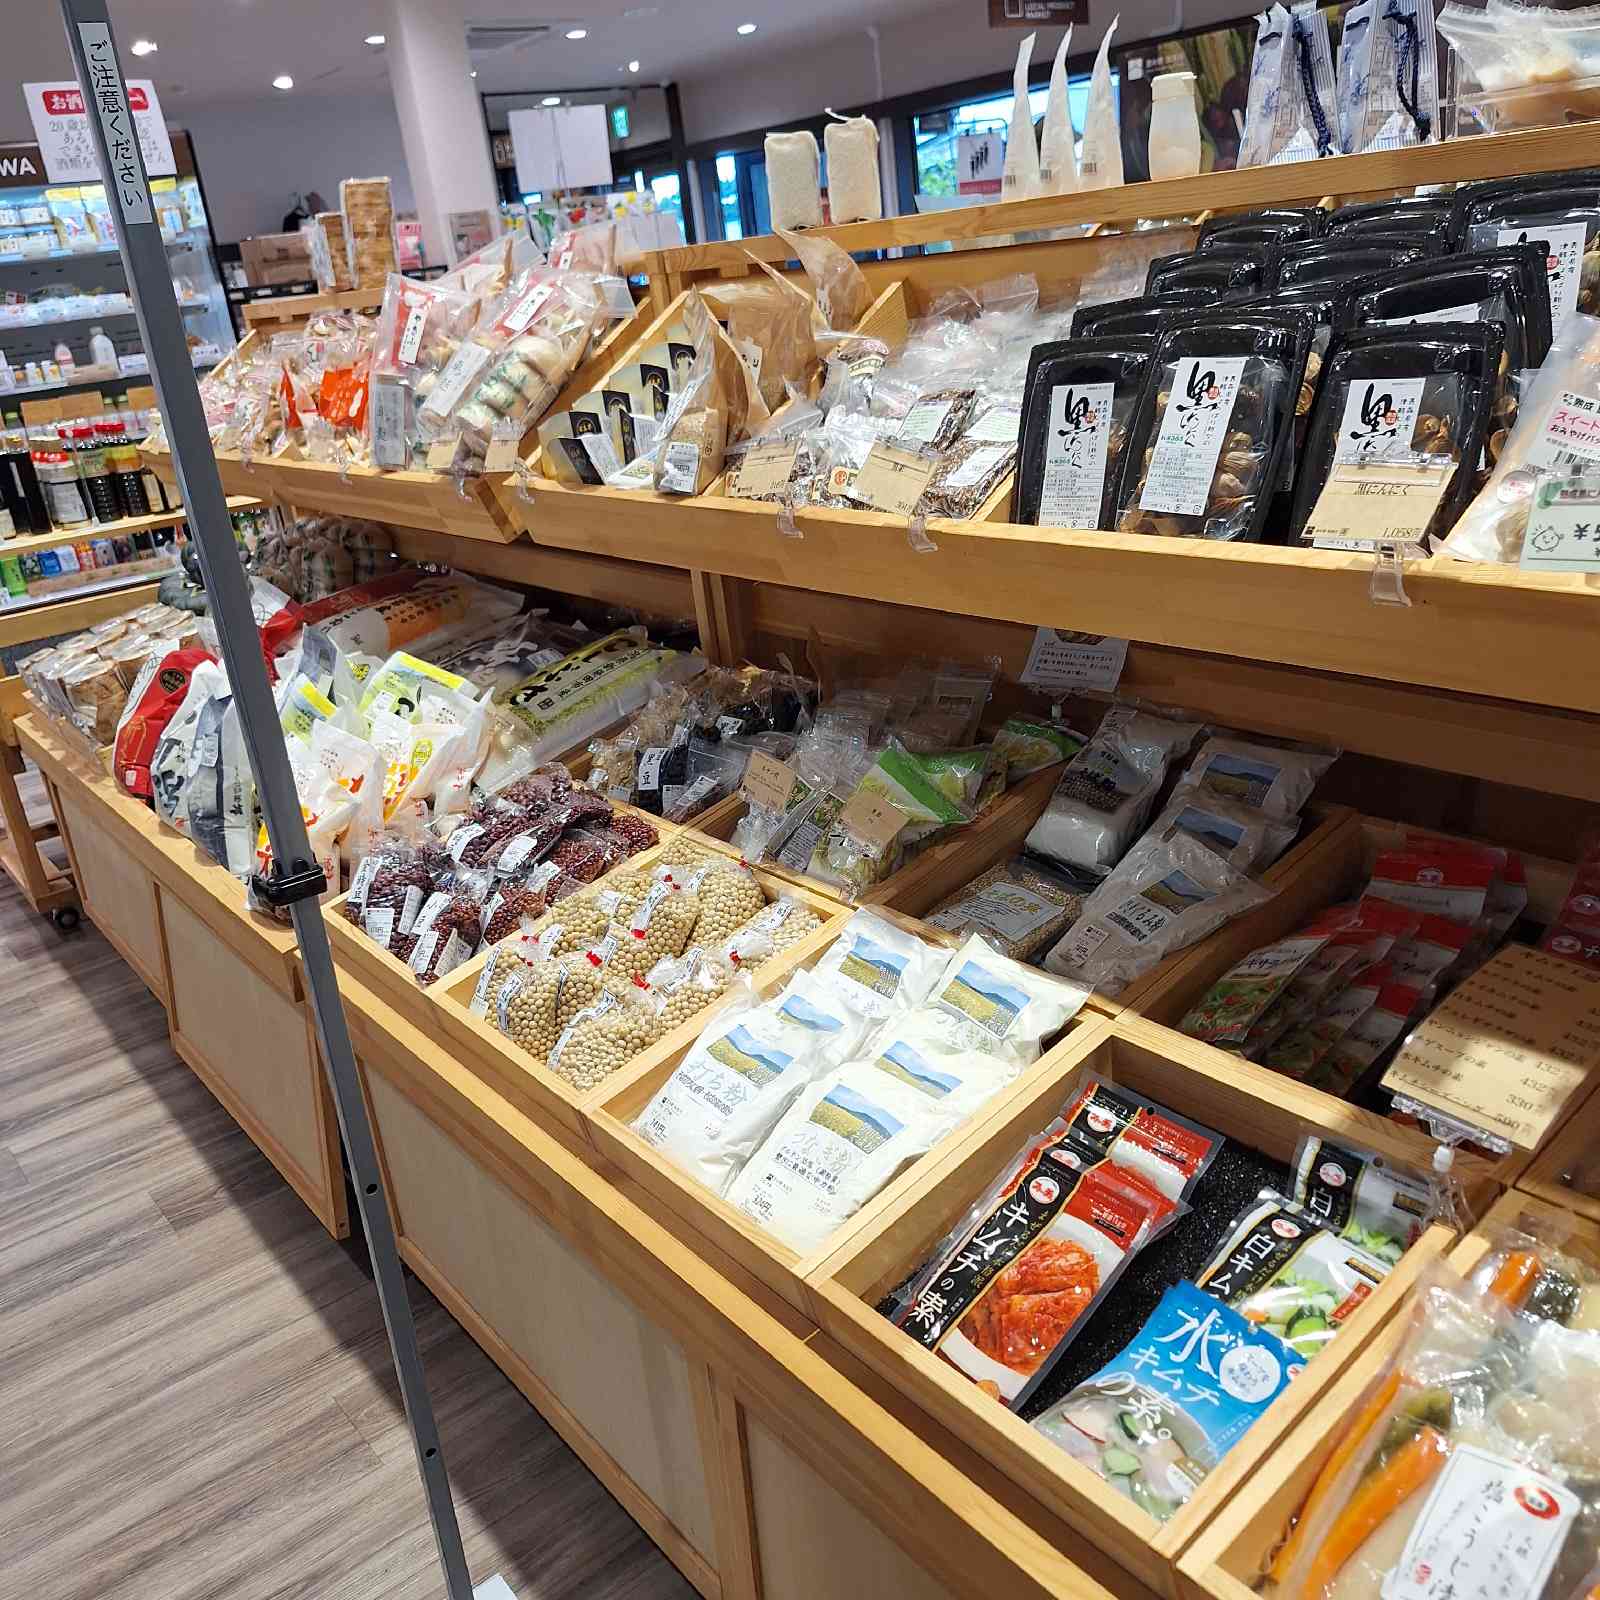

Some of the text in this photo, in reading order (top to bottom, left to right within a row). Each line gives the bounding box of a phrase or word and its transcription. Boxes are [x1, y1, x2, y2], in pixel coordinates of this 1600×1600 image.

[89, 40, 144, 206] ご注意ください
[909, 1201, 1030, 1329] キムチの素
[1209, 1233, 1277, 1298] 白キム
[1130, 1346, 1220, 1406] キムチ
[1153, 1308, 1226, 1380] 水
